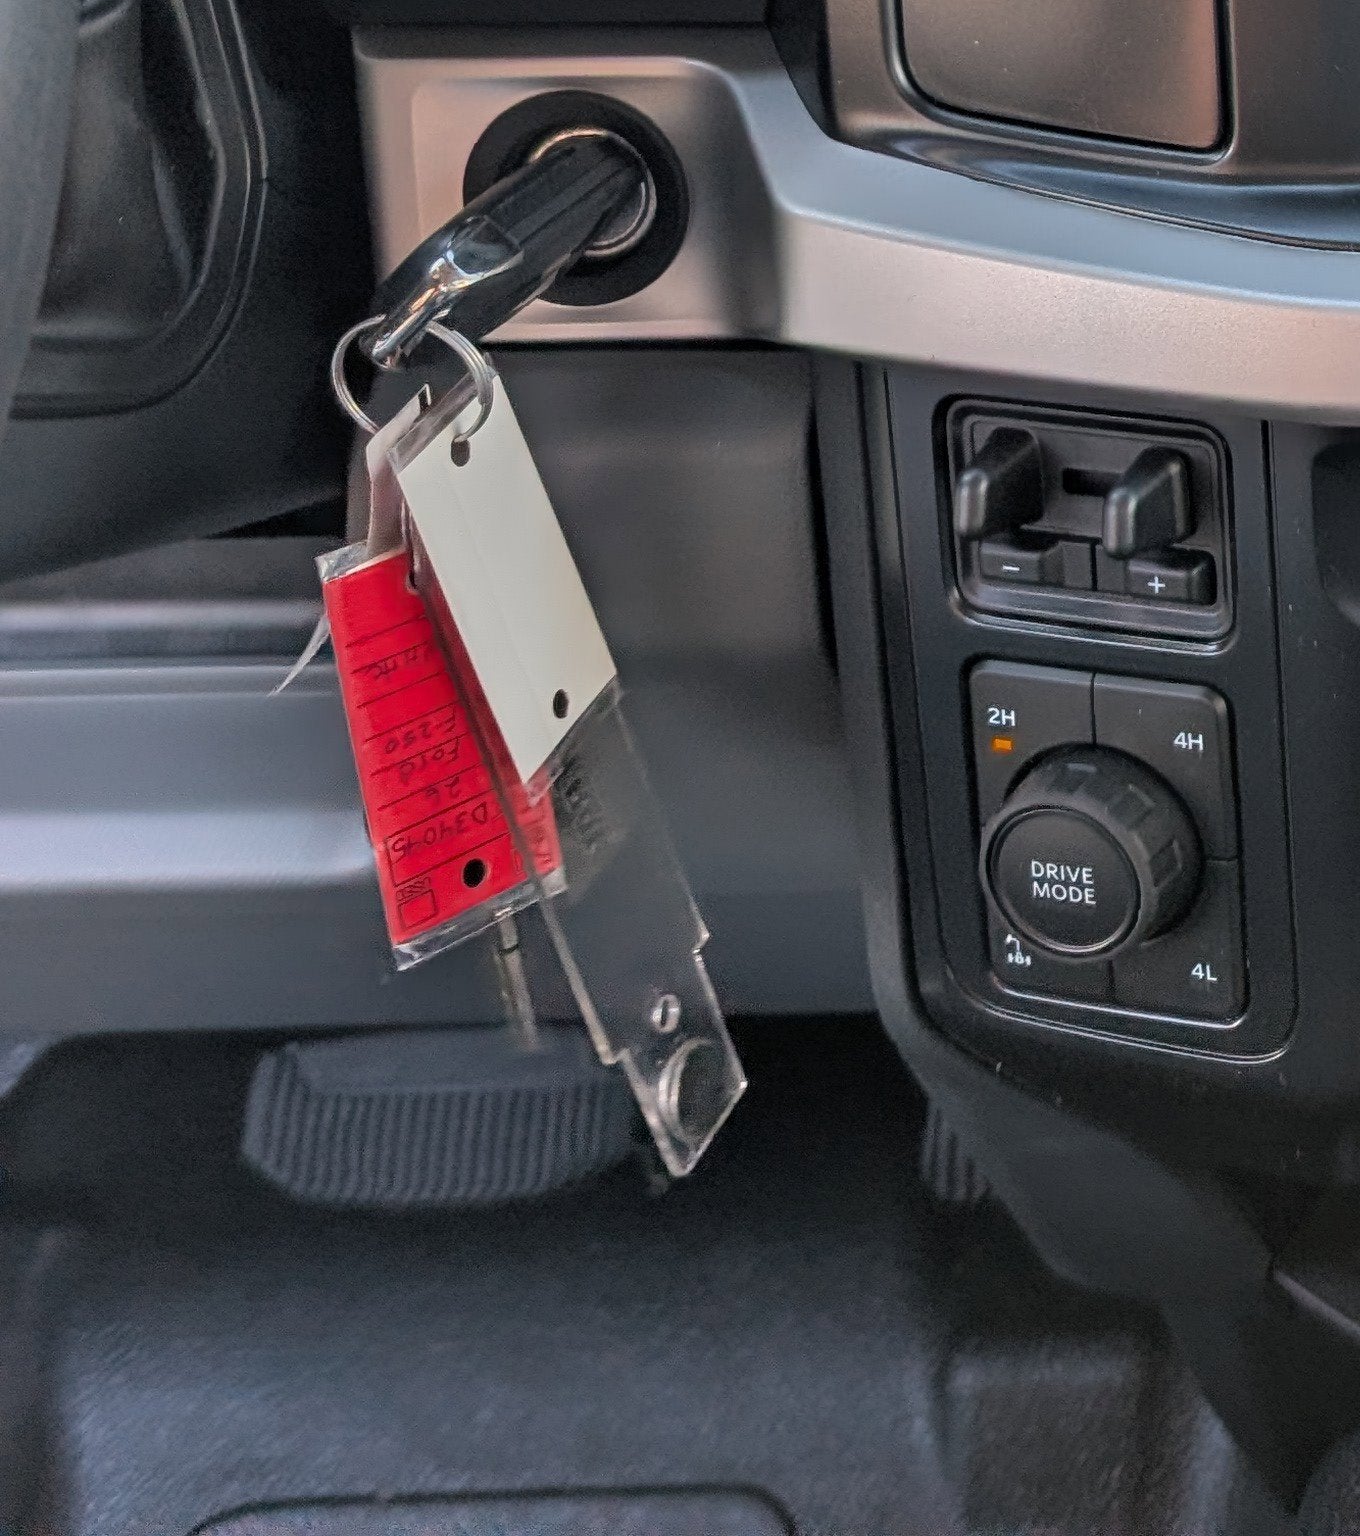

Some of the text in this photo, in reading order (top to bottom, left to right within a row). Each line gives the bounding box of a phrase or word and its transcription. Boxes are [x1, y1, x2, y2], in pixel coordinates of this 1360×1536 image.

[987, 706, 1016, 728] 2H
[1173, 729, 1204, 752] 4H
[1031, 859, 1095, 885] DRIVE
[1032, 880, 1097, 905] MODE
[1191, 963, 1218, 983] 4L
